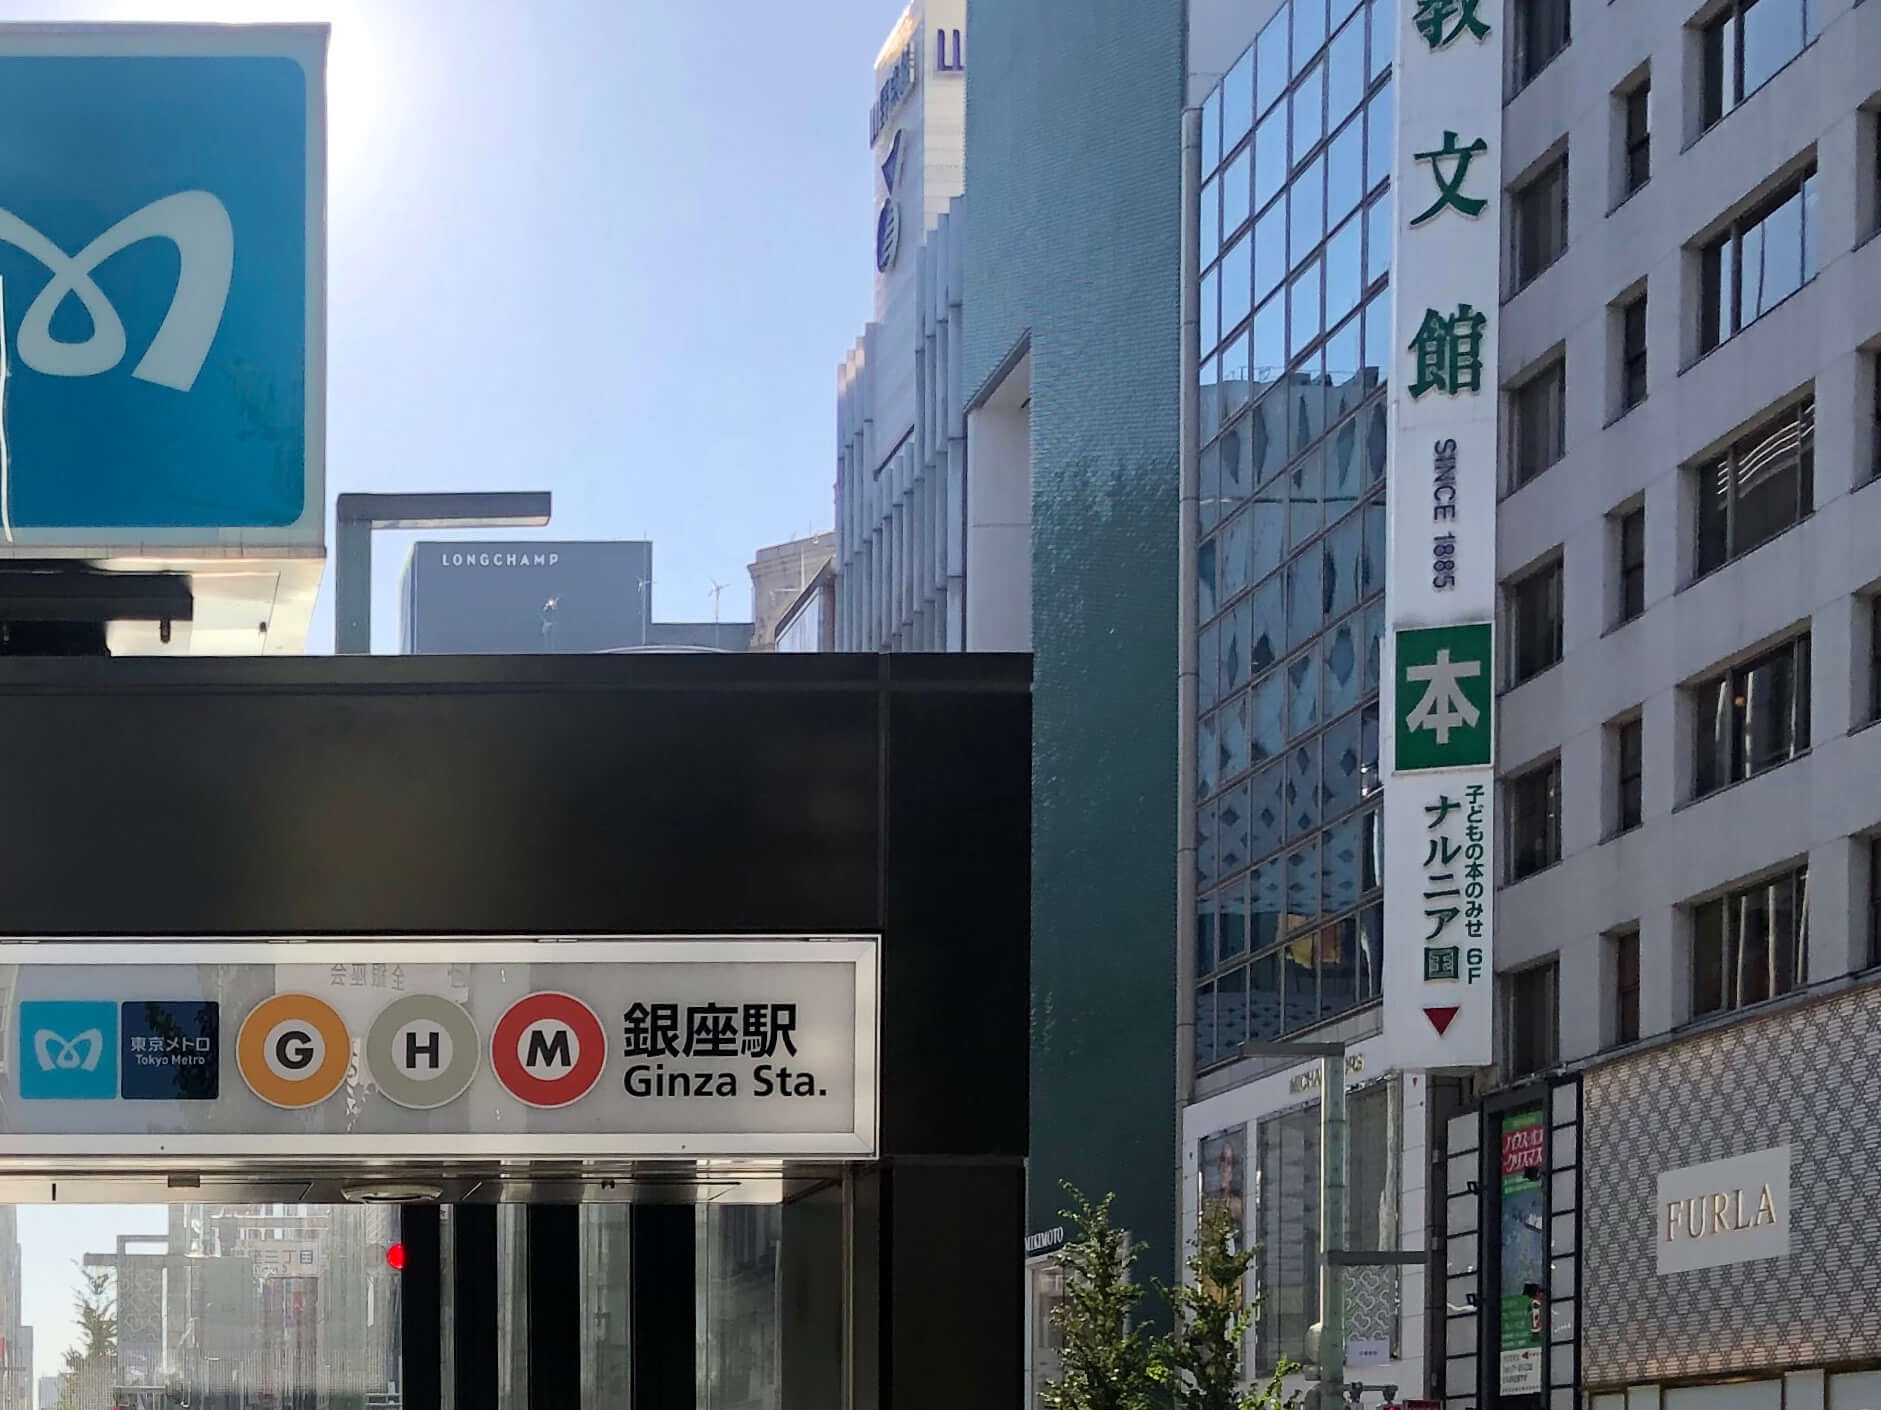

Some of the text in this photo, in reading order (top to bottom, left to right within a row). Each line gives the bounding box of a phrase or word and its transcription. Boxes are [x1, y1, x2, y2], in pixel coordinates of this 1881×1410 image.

[1432, 438, 1457, 591] SINCE 1885
[442, 553, 559, 566] LONGCHAMP
[1406, 649, 1481, 745] 本
[1464, 784, 1485, 938] 子どもの本のみせ
[1423, 794, 1462, 982] ナルニア国
[130, 1036, 210, 1052] 東京メトロ
[275, 1030, 314, 1070] G
[526, 1030, 572, 1067] M
[623, 1002, 798, 1058] 銀座駅
[135, 1054, 206, 1067] Tokyo Metro
[406, 1032, 439, 1069] H
[623, 1063, 827, 1097] Ginza Sta.
[1666, 1183, 1777, 1243] FURLA
